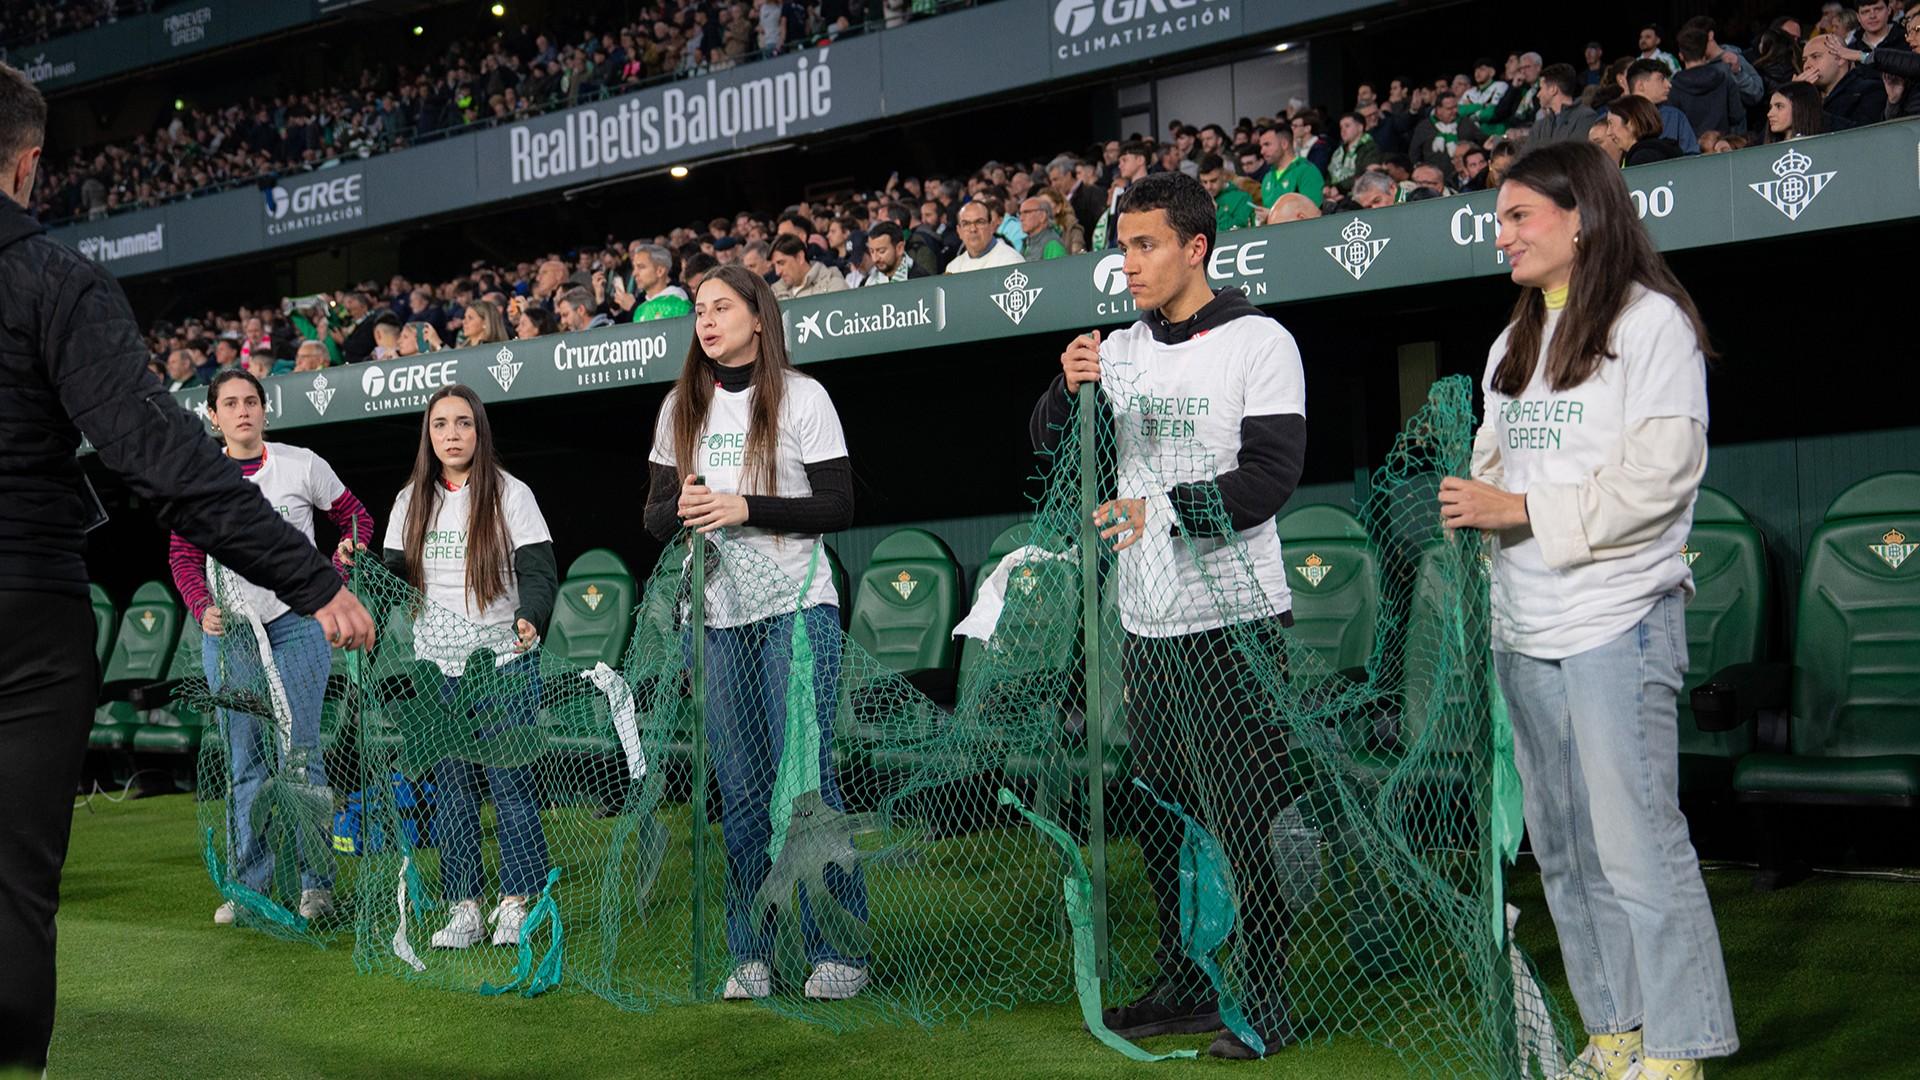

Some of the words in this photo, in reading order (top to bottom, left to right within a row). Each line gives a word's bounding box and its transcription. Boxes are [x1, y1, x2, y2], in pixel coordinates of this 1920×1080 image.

[1057, 6, 1231, 59] CLIMATIZACIÓN
[510, 113, 576, 185] Real
[578, 98, 660, 170] Betis
[664, 48, 832, 151] Balompié
[292, 174, 362, 213] GREE
[268, 205, 363, 236] CLIMATIZACIÓN
[100, 223, 164, 262] hummel
[1207, 240, 1268, 281] EE
[825, 298, 932, 337] CaixaBank
[554, 334, 667, 371] Cruzcampo
[388, 359, 458, 393] GREE
[578, 371, 610, 386] DESDE
[617, 367, 644, 381] 1904
[364, 393, 434, 412] CLIMATIZA
[1129, 396, 1210, 416] FOREVER
[1499, 400, 1584, 425] FOREVER
[1141, 419, 1195, 438] GREEN
[1508, 427, 1561, 450] GREEN
